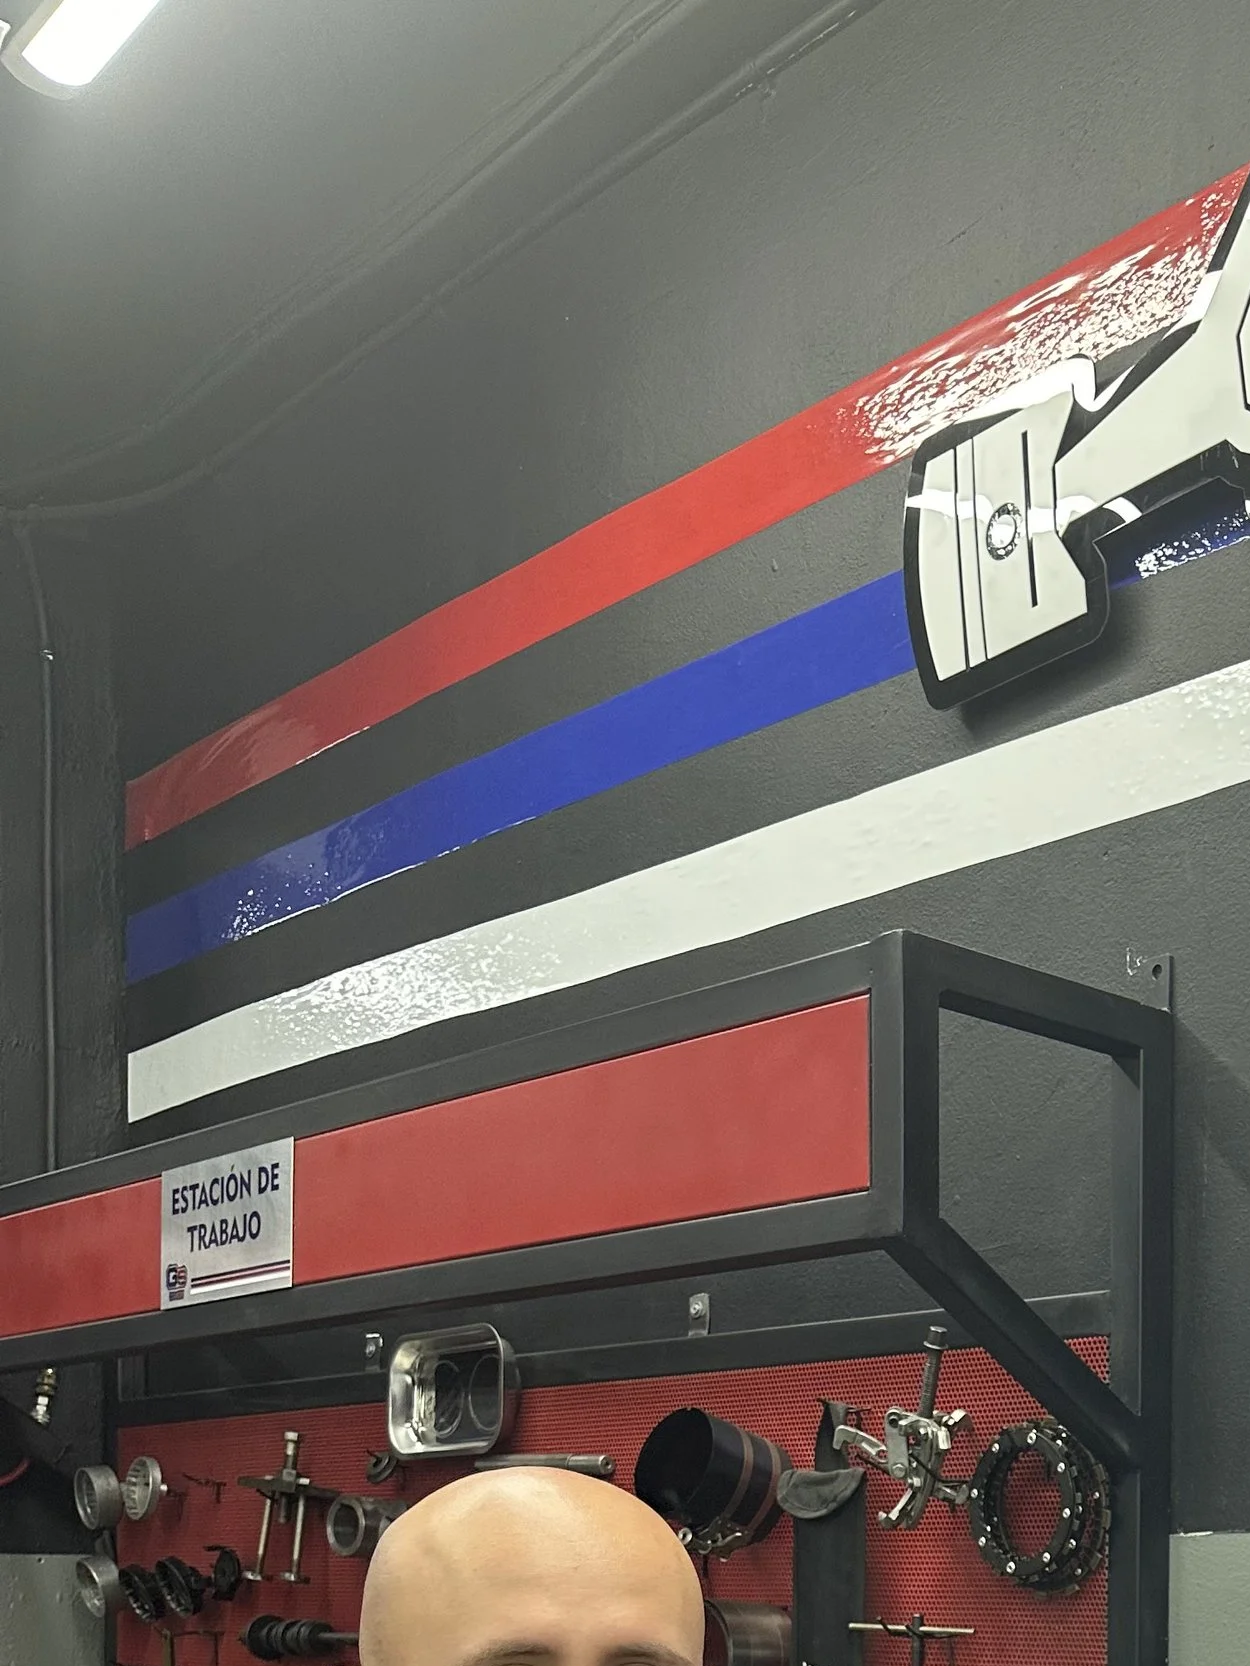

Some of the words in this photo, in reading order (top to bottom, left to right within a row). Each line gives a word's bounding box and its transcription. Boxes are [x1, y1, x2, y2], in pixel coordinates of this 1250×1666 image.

[172, 1165, 251, 1216] ESTACIÓN
[258, 1162, 280, 1195] DE
[187, 1210, 262, 1252] TRABAJO
